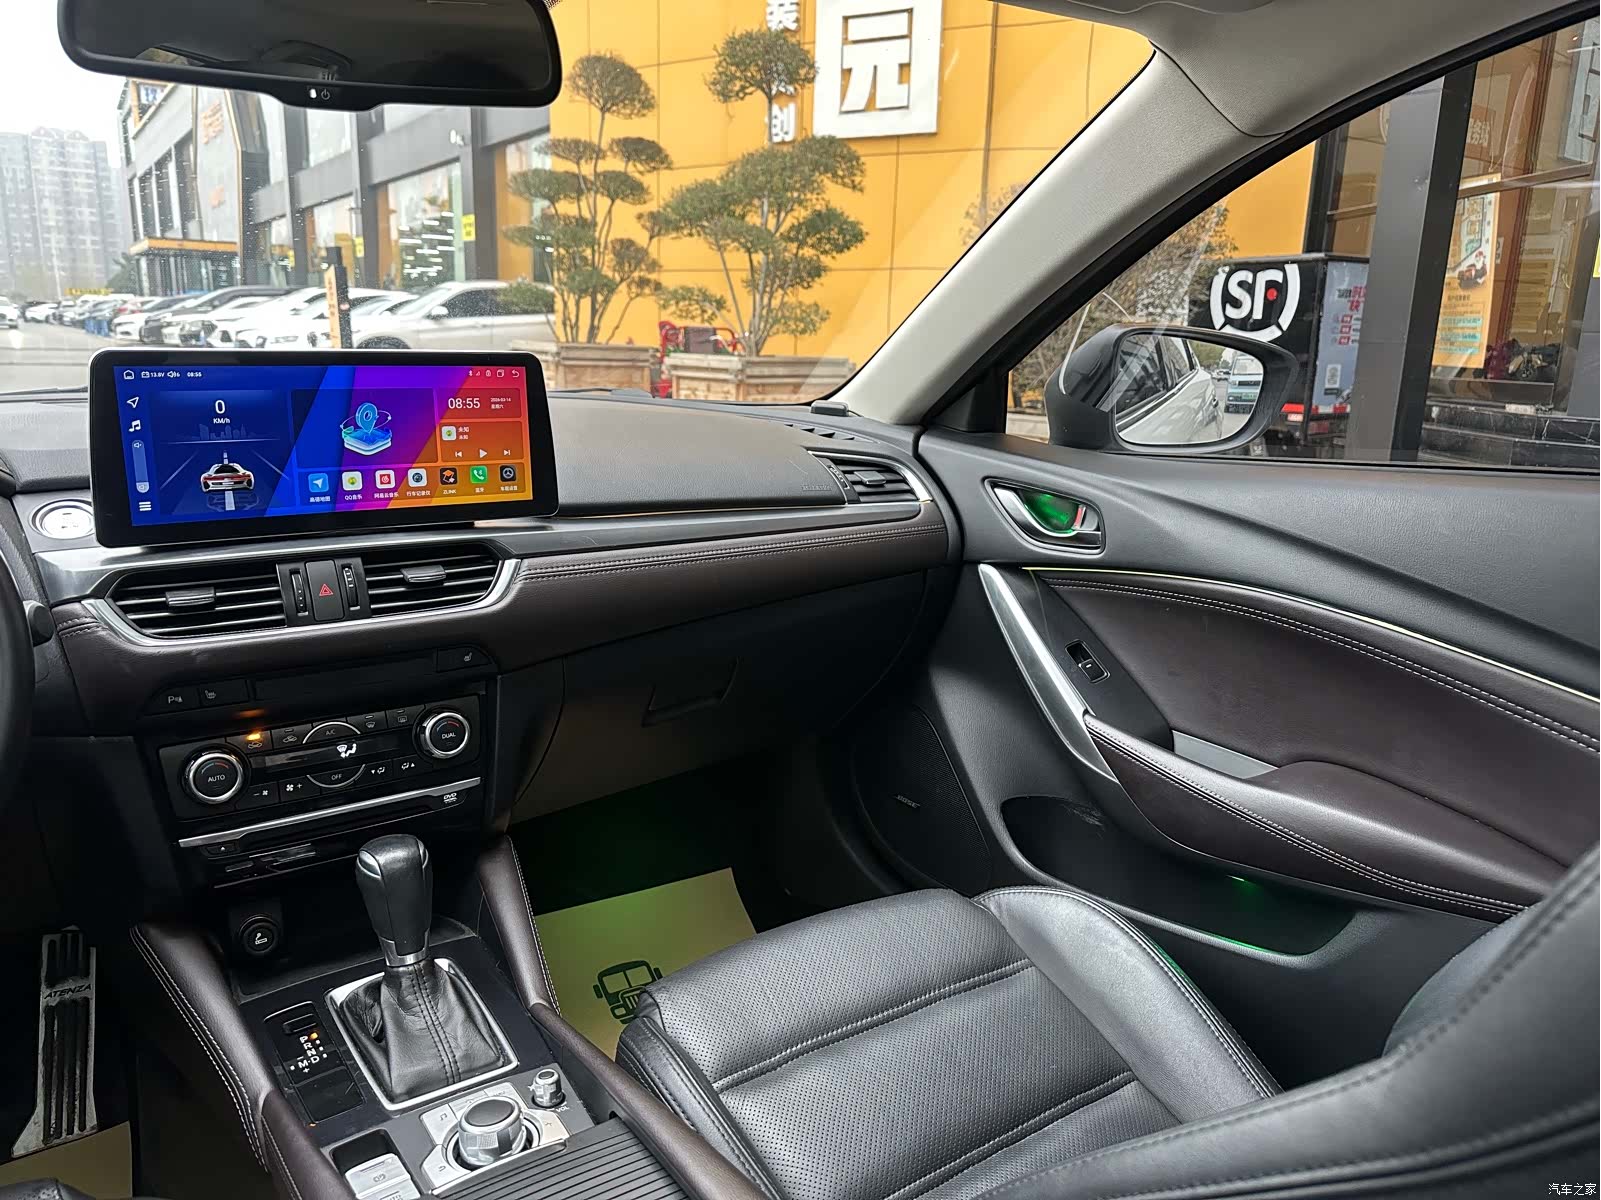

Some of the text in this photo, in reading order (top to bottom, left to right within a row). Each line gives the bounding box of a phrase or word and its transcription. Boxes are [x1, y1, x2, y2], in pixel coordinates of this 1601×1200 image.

[839, 8, 913, 114] 元
[215, 399, 226, 414] 0
[448, 397, 481, 409] 08:55
[441, 731, 457, 739] DUAL
[207, 774, 226, 783] AUTO
[43, 983, 92, 1000] ATENZA
[555, 1105, 570, 1113] VOL
